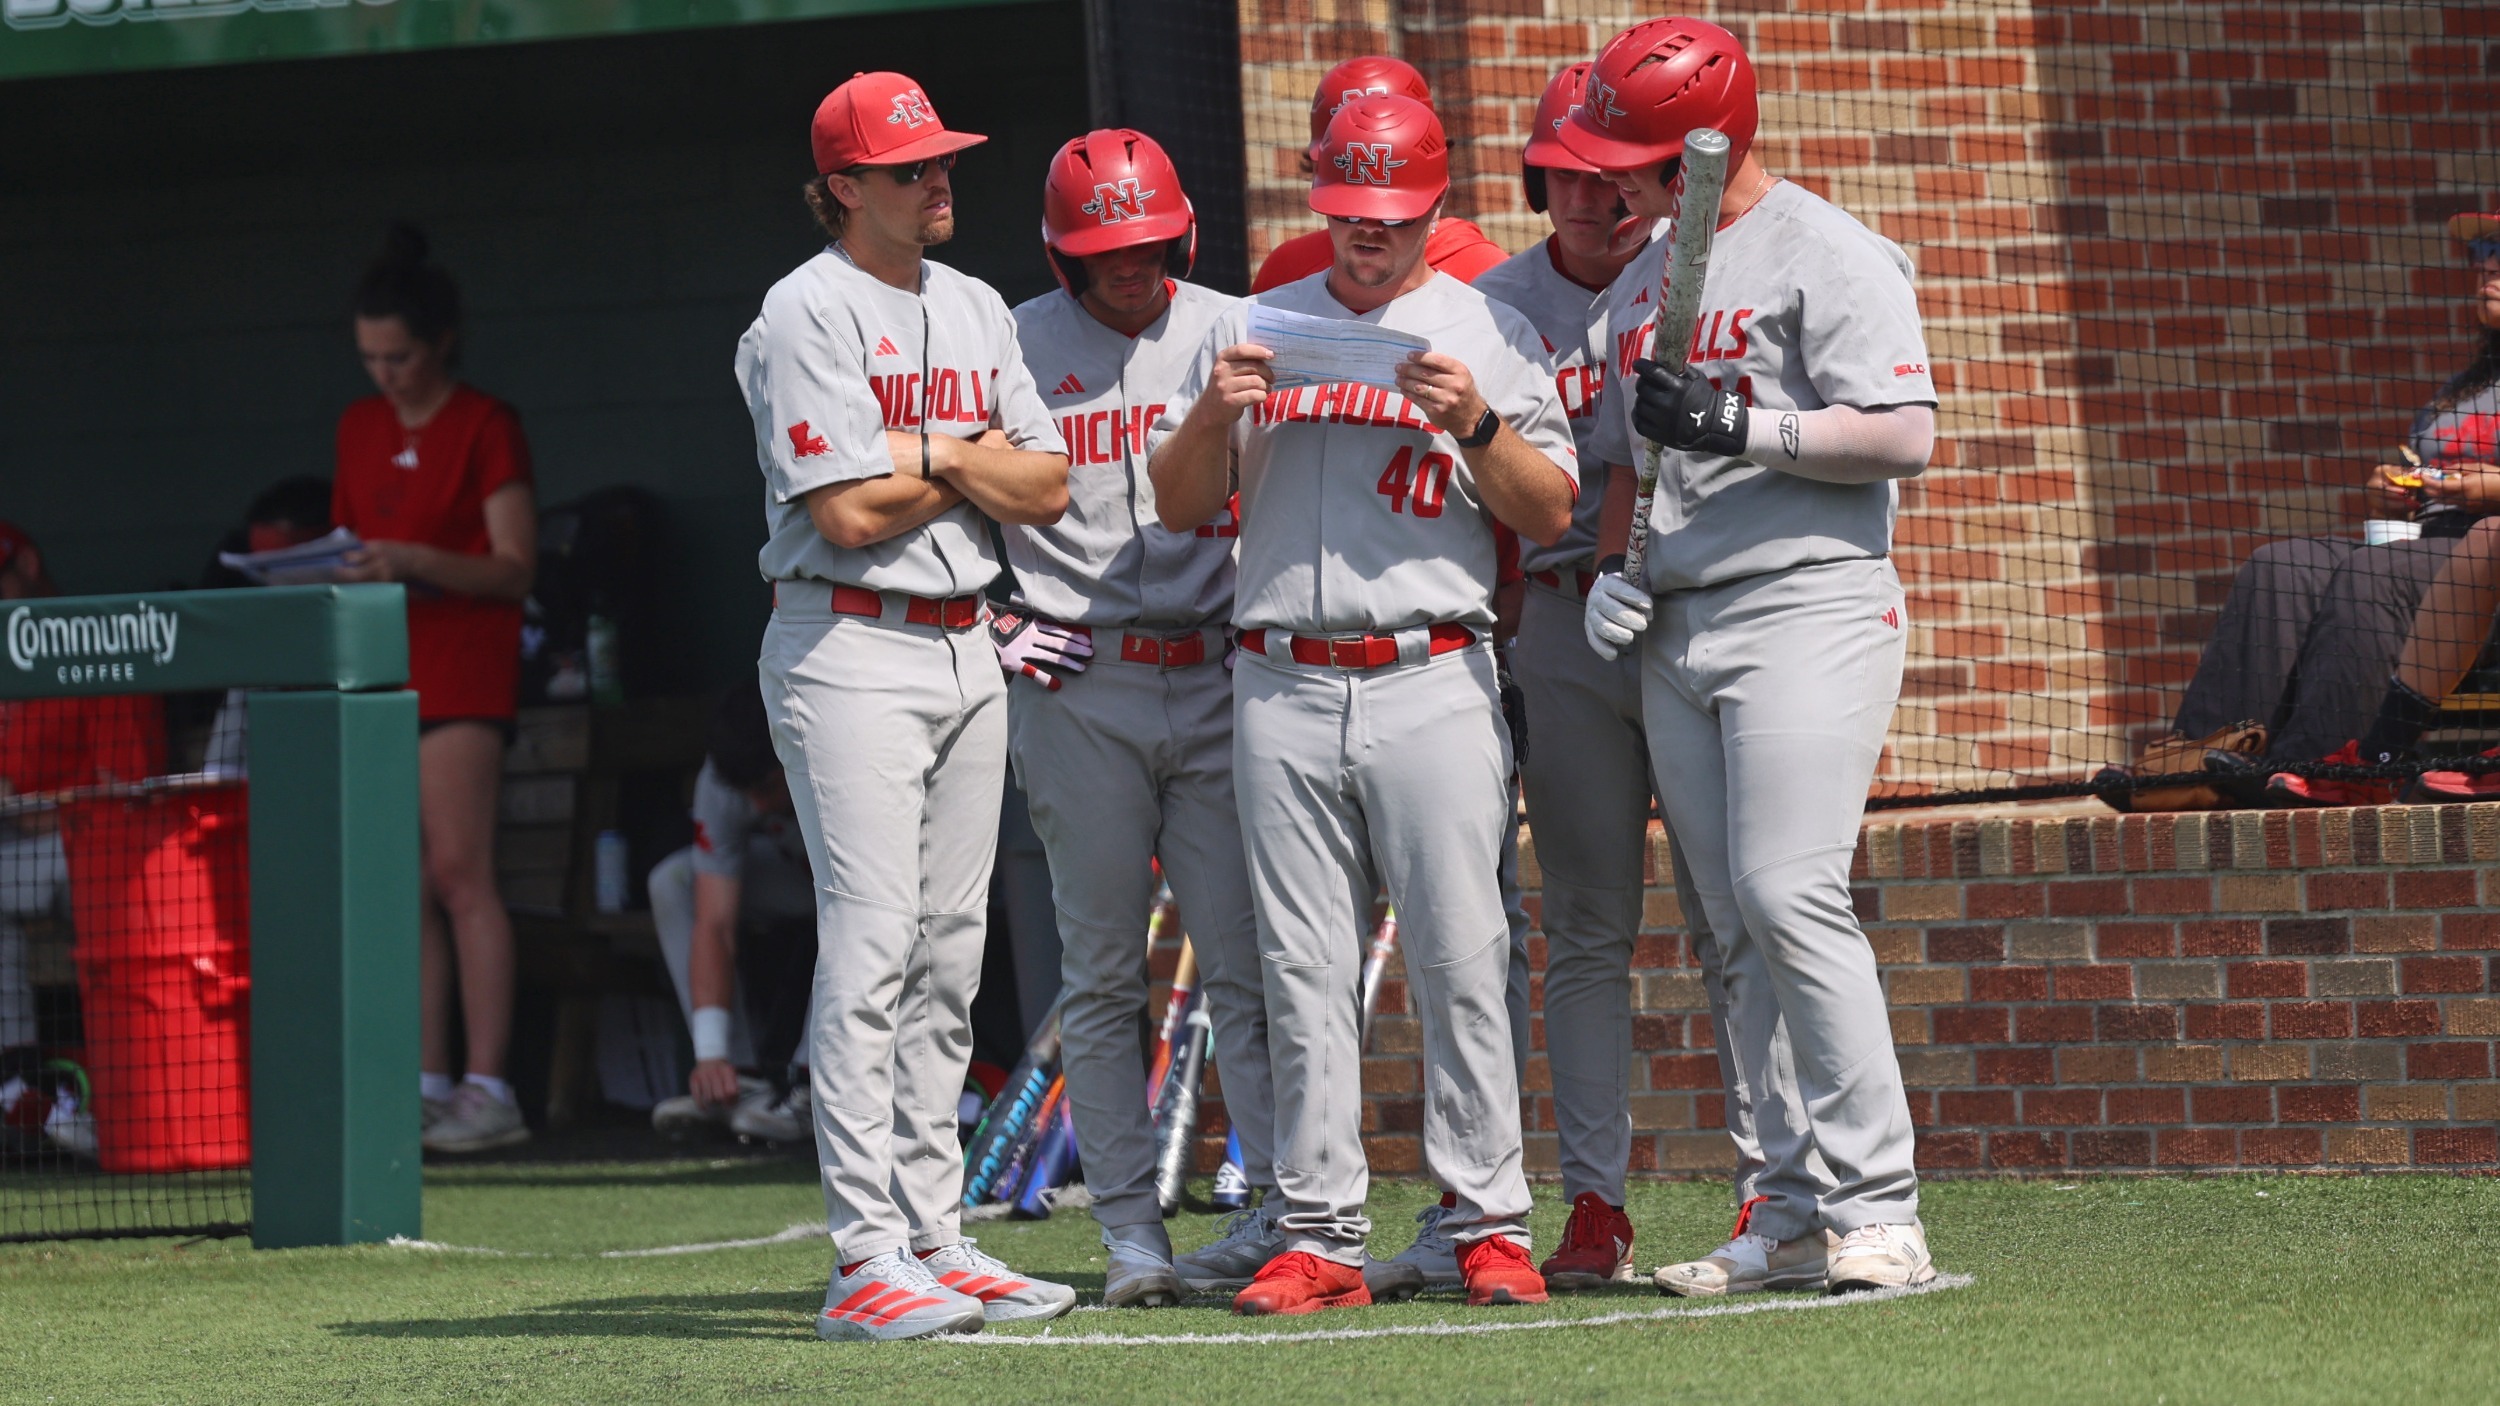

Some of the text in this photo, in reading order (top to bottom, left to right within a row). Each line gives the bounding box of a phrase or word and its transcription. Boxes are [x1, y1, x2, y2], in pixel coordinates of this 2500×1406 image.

[1346, 142, 1391, 184] N
[1094, 177, 1145, 225] N
[869, 367, 999, 427] NICHOLL
[1253, 382, 1445, 434] NICHOLL
[1721, 392, 1739, 432] JAX
[1377, 445, 1453, 518] 40
[8, 600, 177, 671] Community
[57, 663, 134, 684] COFFEE
